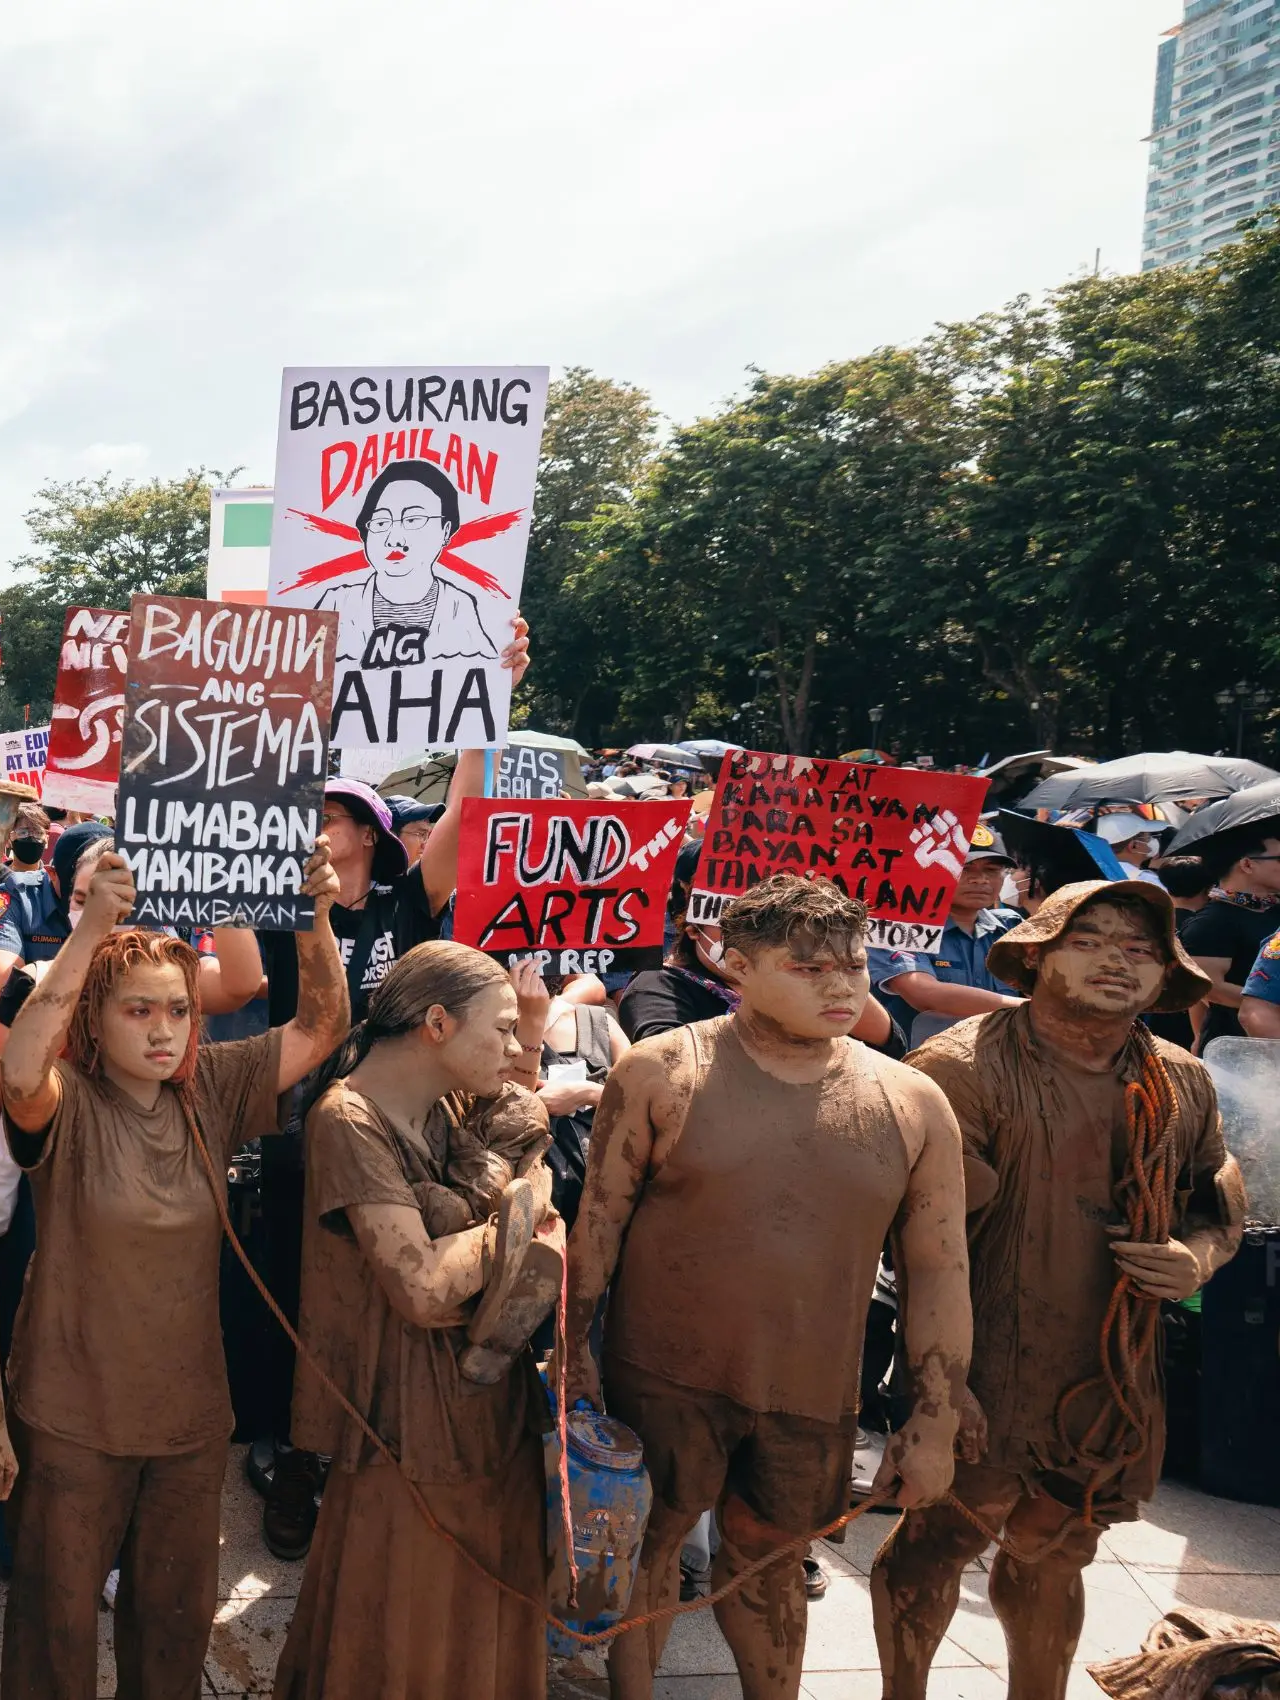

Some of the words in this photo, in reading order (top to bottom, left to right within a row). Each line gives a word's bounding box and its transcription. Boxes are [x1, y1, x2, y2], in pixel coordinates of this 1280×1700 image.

[290, 375, 532, 431] BASURANG
[321, 428, 498, 513] DAHILAN
[138, 605, 327, 682] BAGUHIN
[371, 630, 422, 666] NG
[330, 668, 497, 743] AHA
[6, 754, 23, 770] AT
[123, 698, 322, 790] SISTEMA
[721, 781, 940, 824] KAMATAYAN
[839, 767, 877, 791] AT
[124, 796, 318, 853] LUMABAN
[483, 811, 632, 888] FUND
[628, 817, 682, 872] THE
[712, 830, 840, 867] BAYAN
[851, 848, 903, 874] AT
[722, 808, 817, 838] PARA
[830, 817, 874, 845] SA
[477, 888, 650, 947] ARTS
[560, 950, 615, 975] REP
